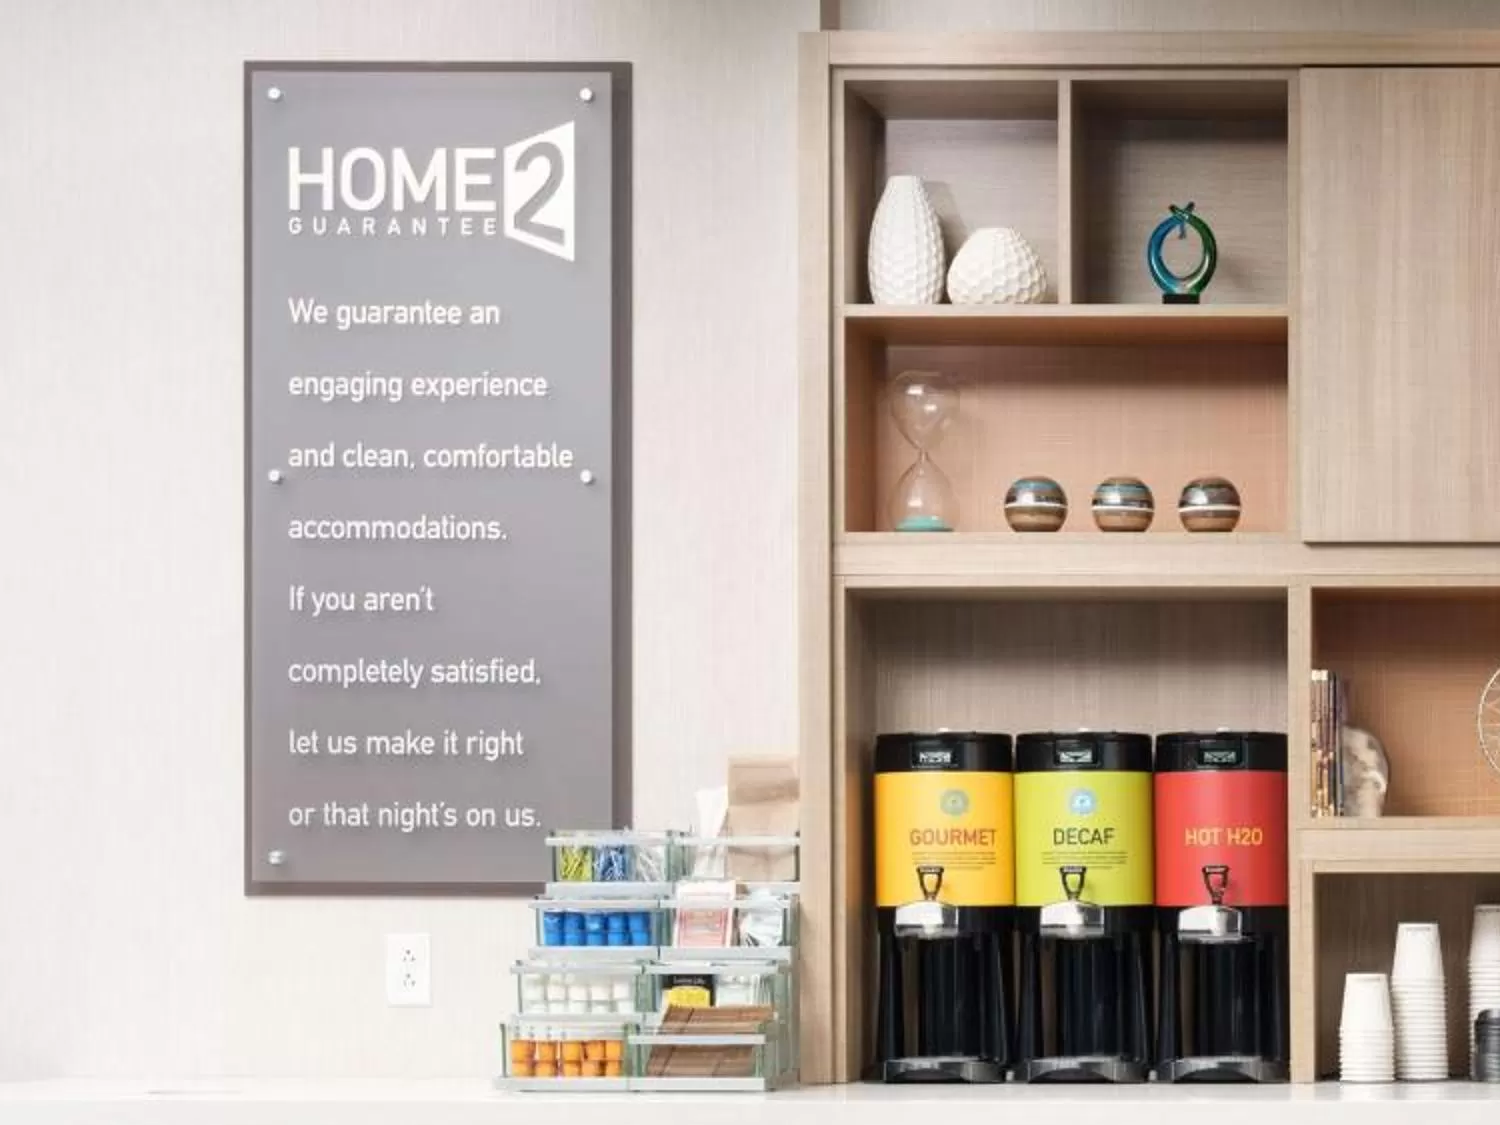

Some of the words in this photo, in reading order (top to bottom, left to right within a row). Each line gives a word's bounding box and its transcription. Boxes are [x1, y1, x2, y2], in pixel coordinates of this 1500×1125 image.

[288, 146, 498, 213] HOME
[288, 216, 498, 237] GUARANTEE
[288, 298, 329, 326] We
[336, 300, 462, 332] guarantee
[469, 305, 501, 326] an
[288, 371, 403, 404] engaging
[410, 371, 548, 404] experience
[288, 442, 335, 469] and
[342, 442, 416, 471] clean,
[423, 442, 574, 469] comfortable
[288, 515, 508, 541] accommodations.
[288, 586, 305, 612] If
[311, 591, 355, 618] you
[363, 586, 434, 612] aren't
[288, 658, 425, 689] completely
[430, 658, 542, 686] satisfied,
[288, 729, 319, 755] let
[327, 735, 358, 756] us
[366, 729, 436, 756] make
[443, 729, 459, 756] it
[466, 729, 525, 763] right
[288, 807, 317, 828] or
[323, 801, 370, 828] that
[378, 801, 458, 834] night's
[465, 807, 496, 828] on
[505, 807, 542, 828] us.
[909, 827, 998, 847] GOURMET
[1052, 827, 1116, 846] DECAF
[1184, 827, 1223, 846] HOT
